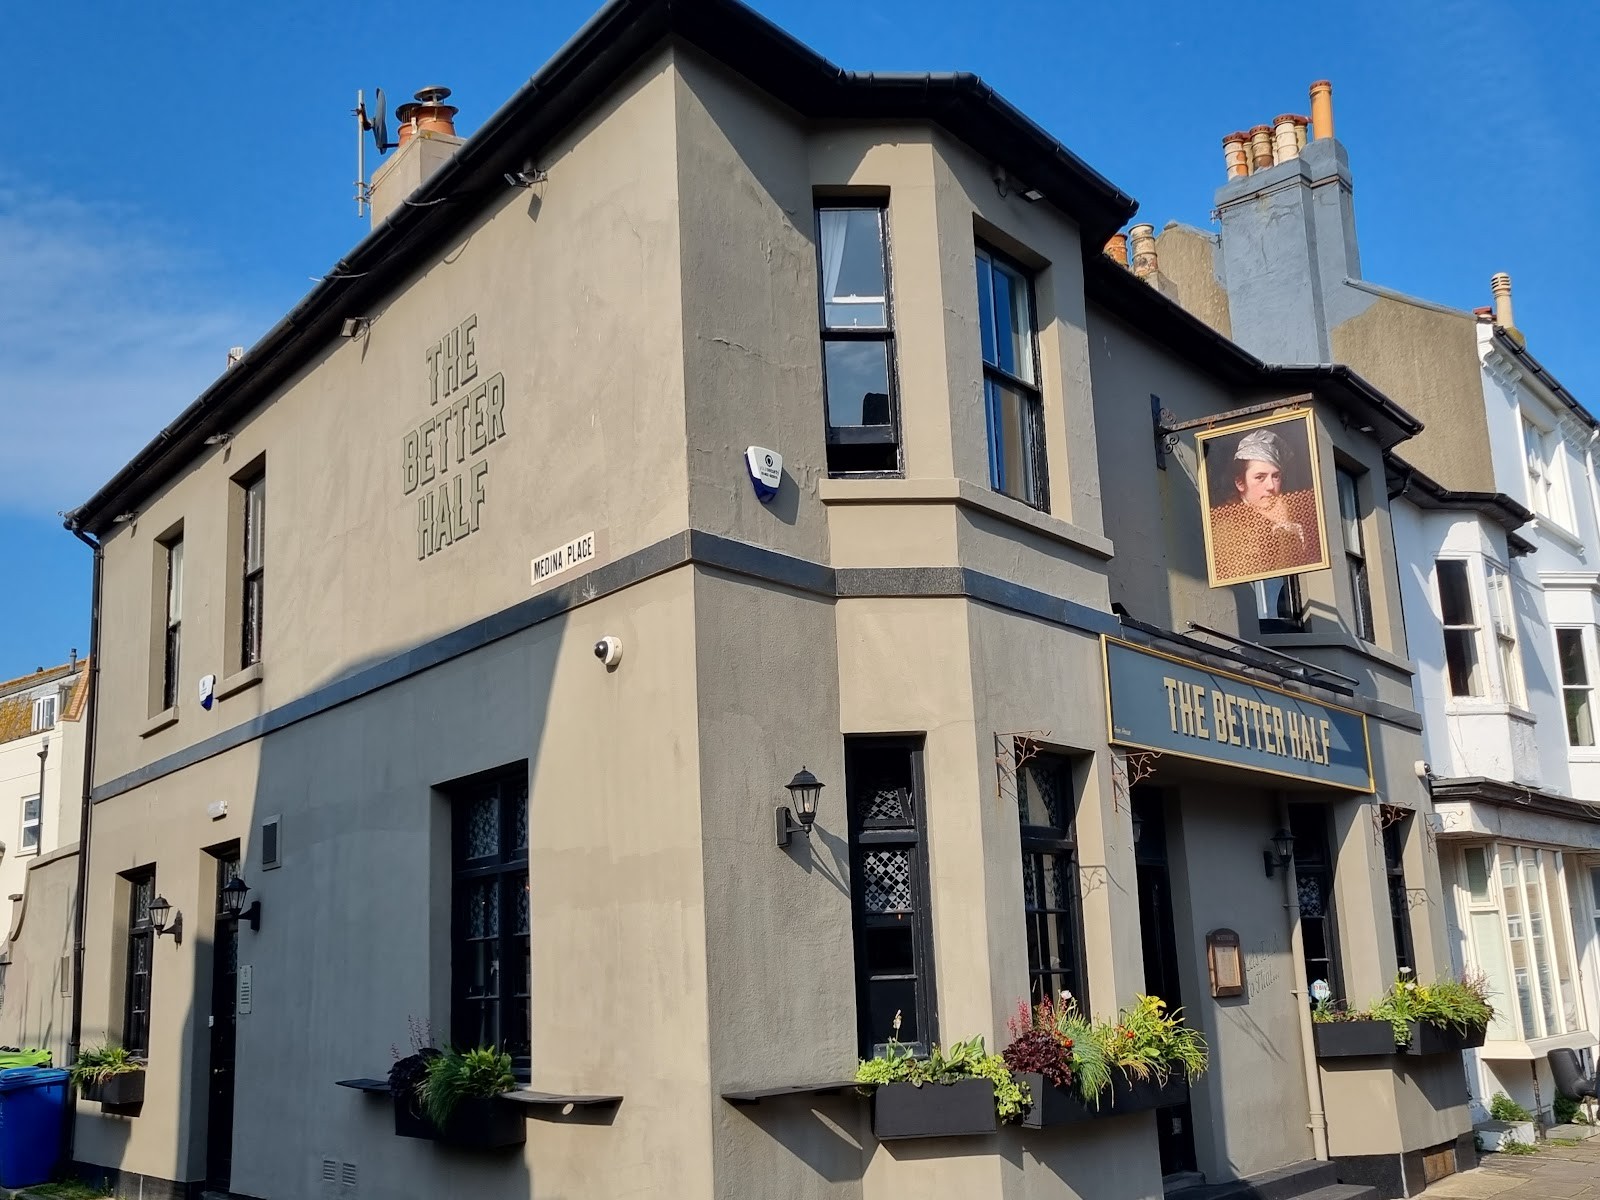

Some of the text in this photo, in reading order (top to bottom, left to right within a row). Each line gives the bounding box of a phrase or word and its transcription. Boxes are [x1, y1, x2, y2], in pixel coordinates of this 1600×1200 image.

[425, 313, 478, 406] THE
[402, 371, 506, 496] BETTER
[417, 459, 488, 561] HALF
[533, 536, 592, 581] MEDINA PLACE
[1163, 676, 1330, 767] THE BETTER HALF
